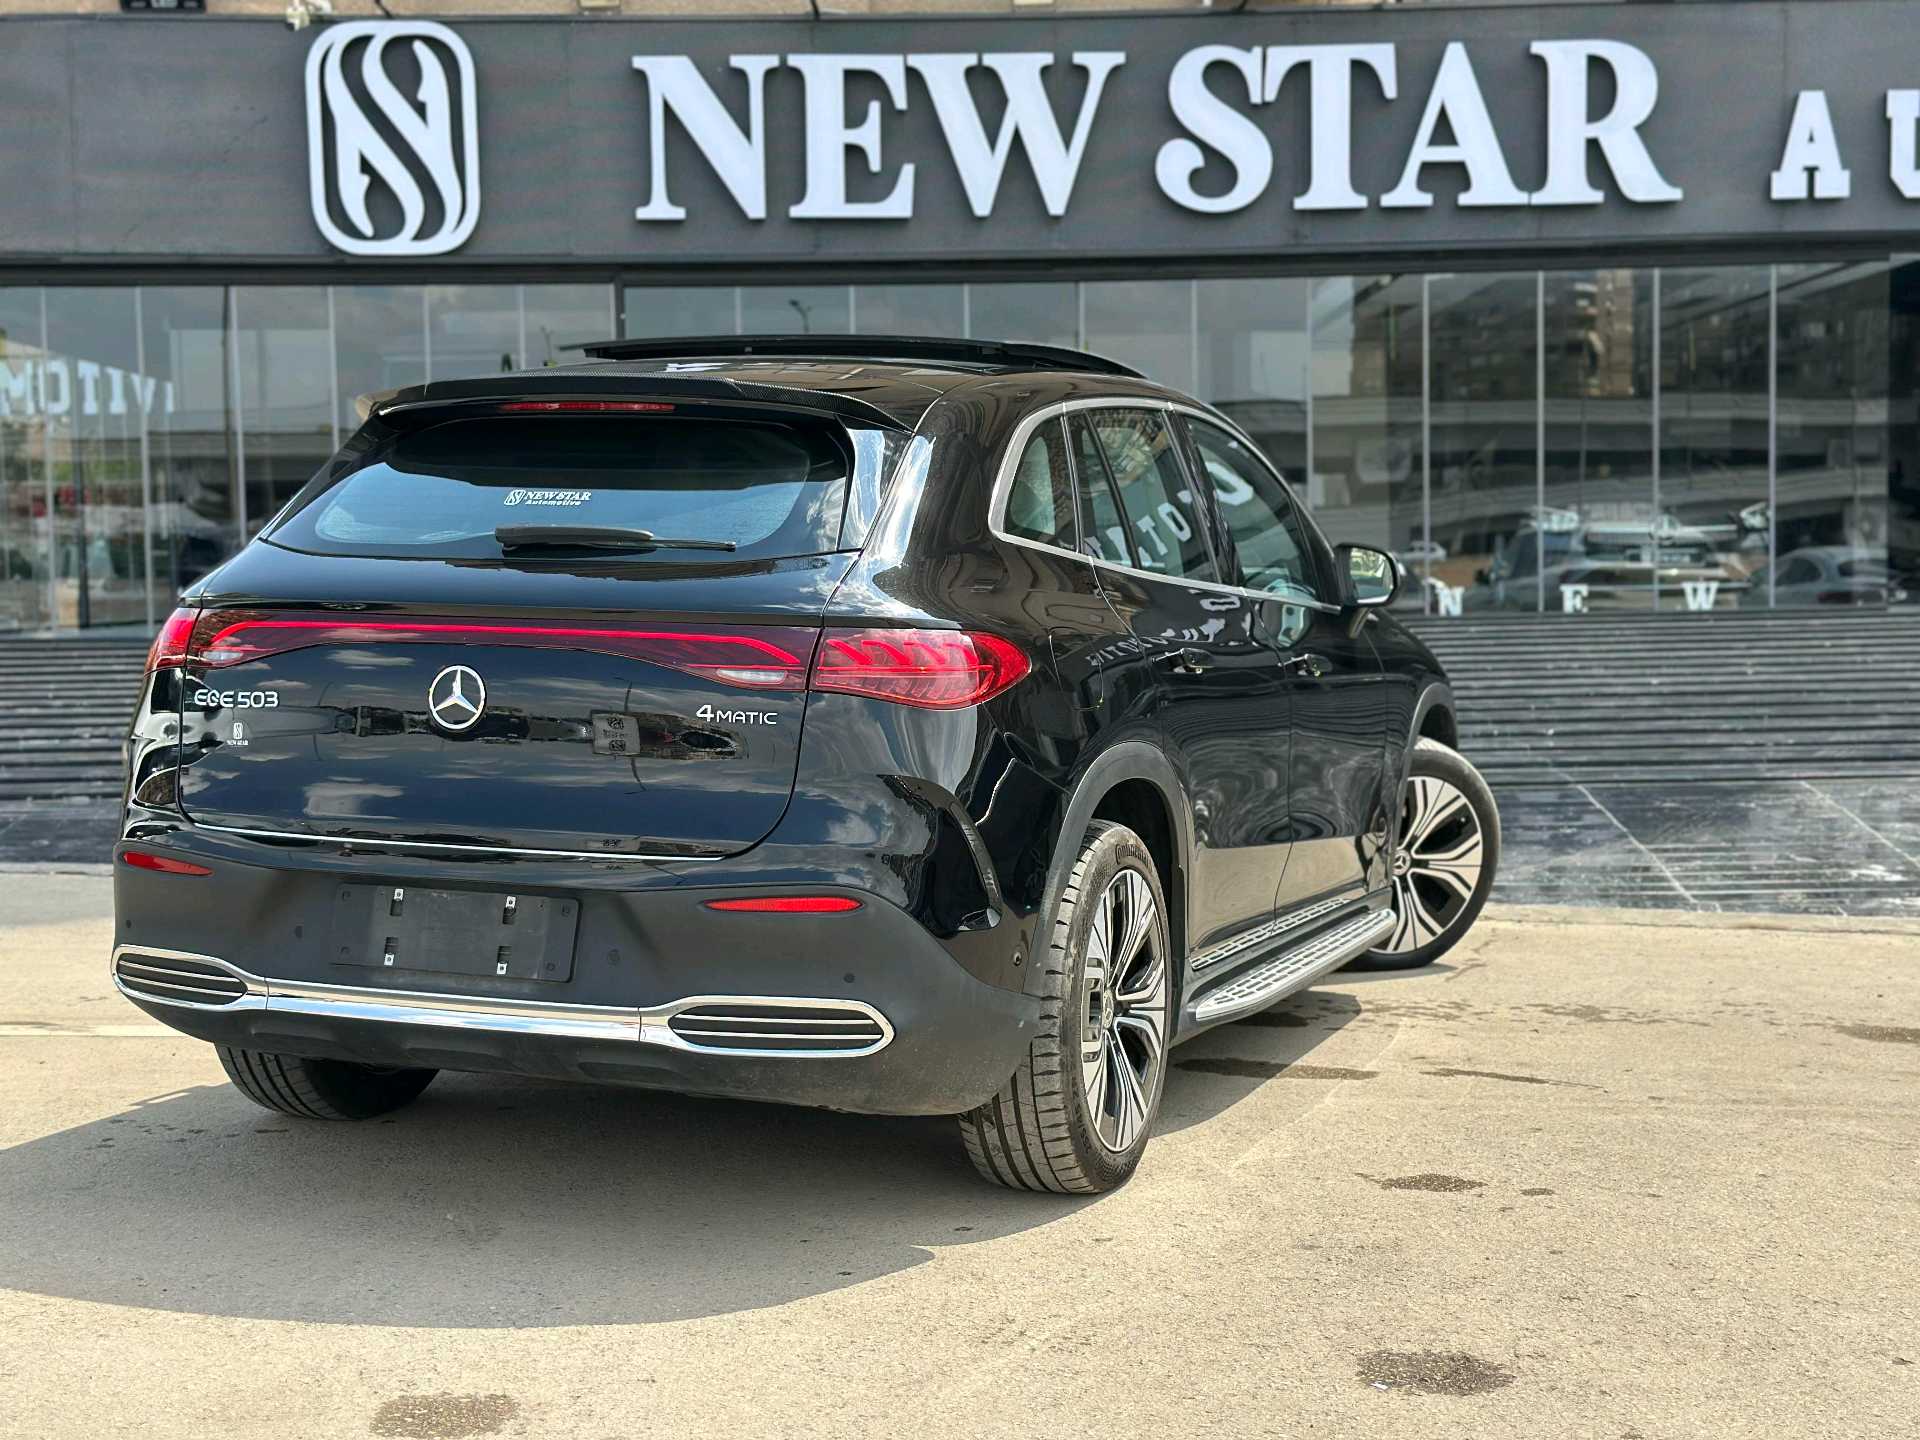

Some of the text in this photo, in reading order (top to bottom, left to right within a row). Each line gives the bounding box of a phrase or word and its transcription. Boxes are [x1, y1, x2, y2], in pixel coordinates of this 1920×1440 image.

[632, 52, 1127, 220] NEW
[1155, 38, 1684, 213] STAR
[237, 691, 279, 709] 503
[695, 703, 779, 726] 4MATIC
